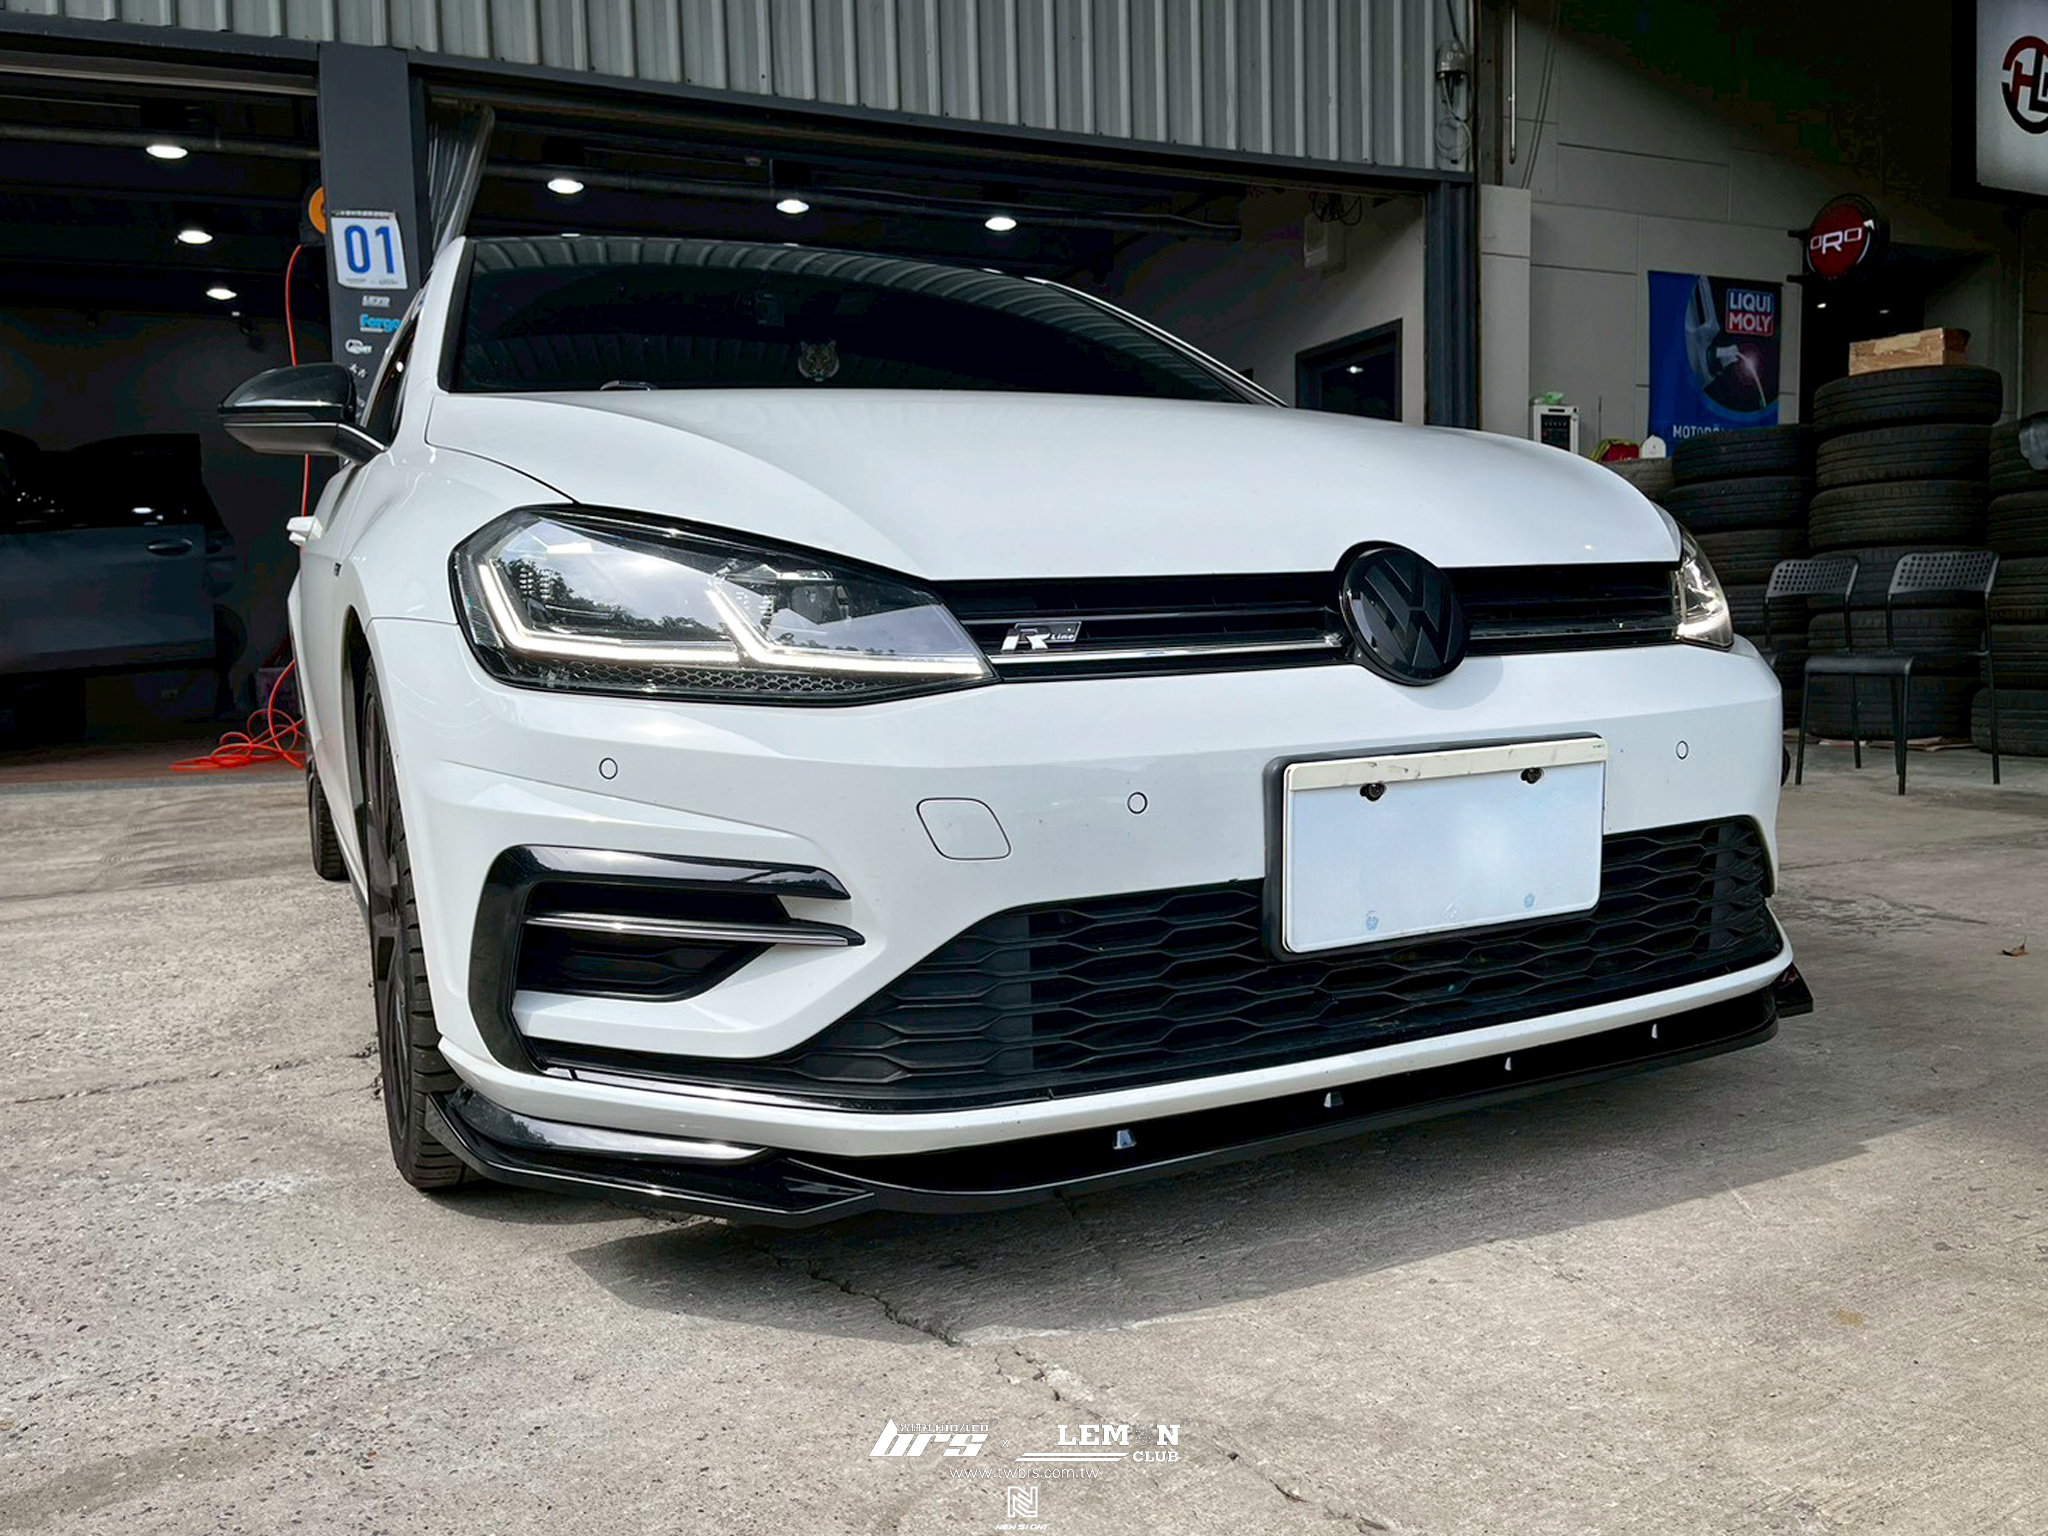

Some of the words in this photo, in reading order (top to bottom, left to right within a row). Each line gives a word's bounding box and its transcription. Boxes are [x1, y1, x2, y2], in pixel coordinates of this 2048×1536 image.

[344, 225, 394, 273] 01
[1729, 292, 1772, 313] LIQUI
[1729, 312, 1772, 332] MOLY
